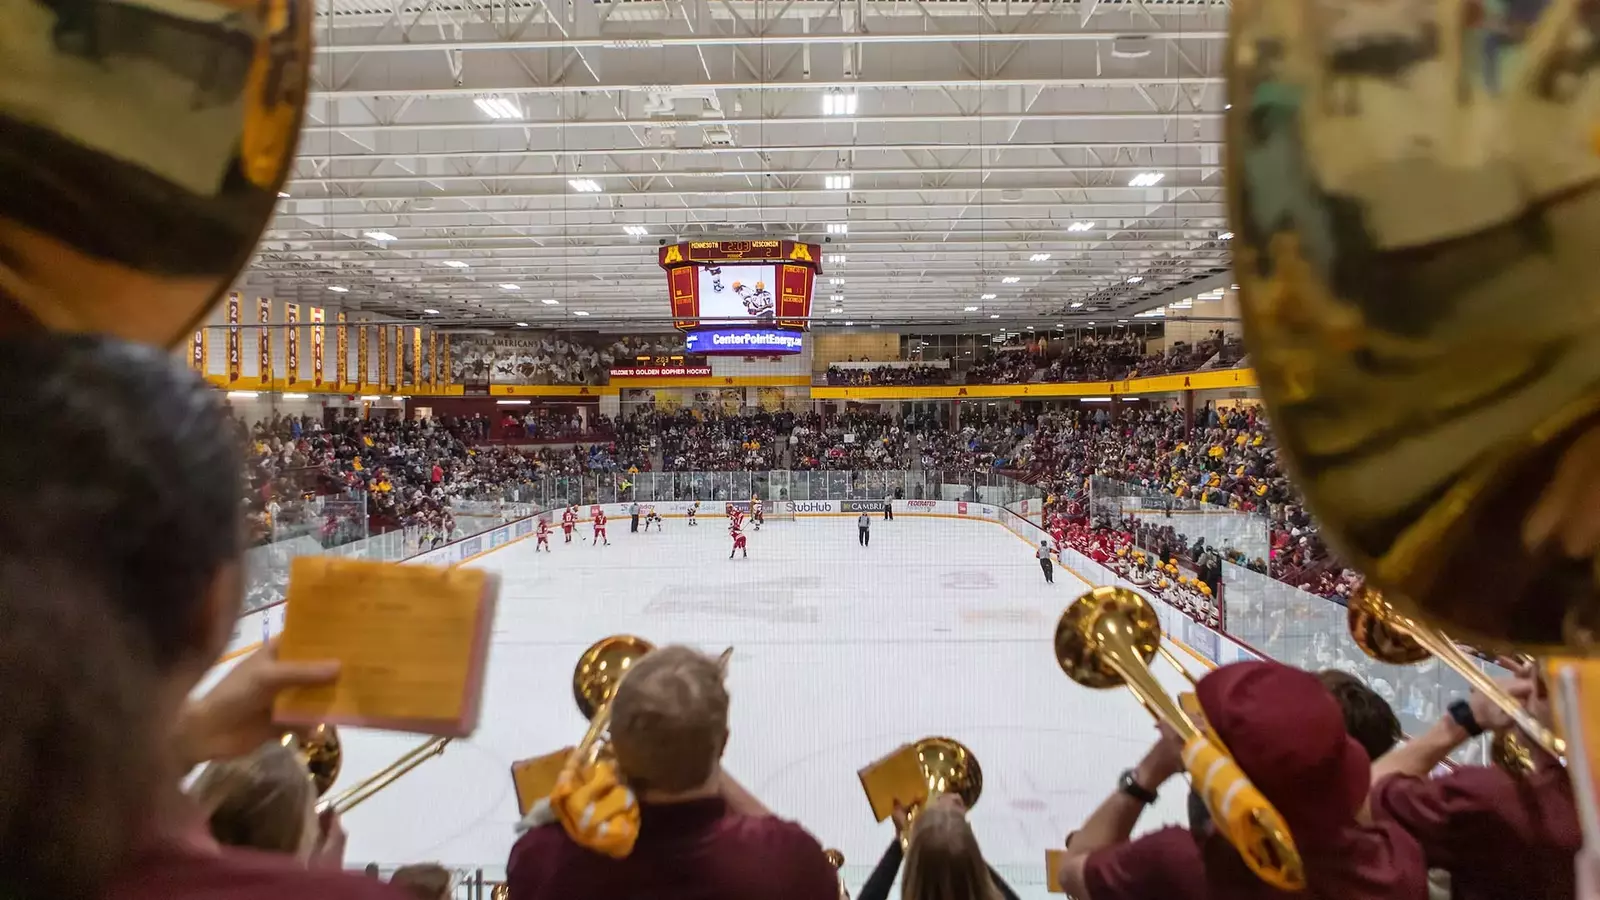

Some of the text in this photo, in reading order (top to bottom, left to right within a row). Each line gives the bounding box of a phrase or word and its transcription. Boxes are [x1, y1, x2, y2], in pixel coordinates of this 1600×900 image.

[727, 242, 749, 251] 2:03
[230, 308, 238, 363] 2012
[261, 314, 269, 365] 2013
[492, 340, 540, 348] AMERICANS
[786, 502, 831, 512] StubHub
